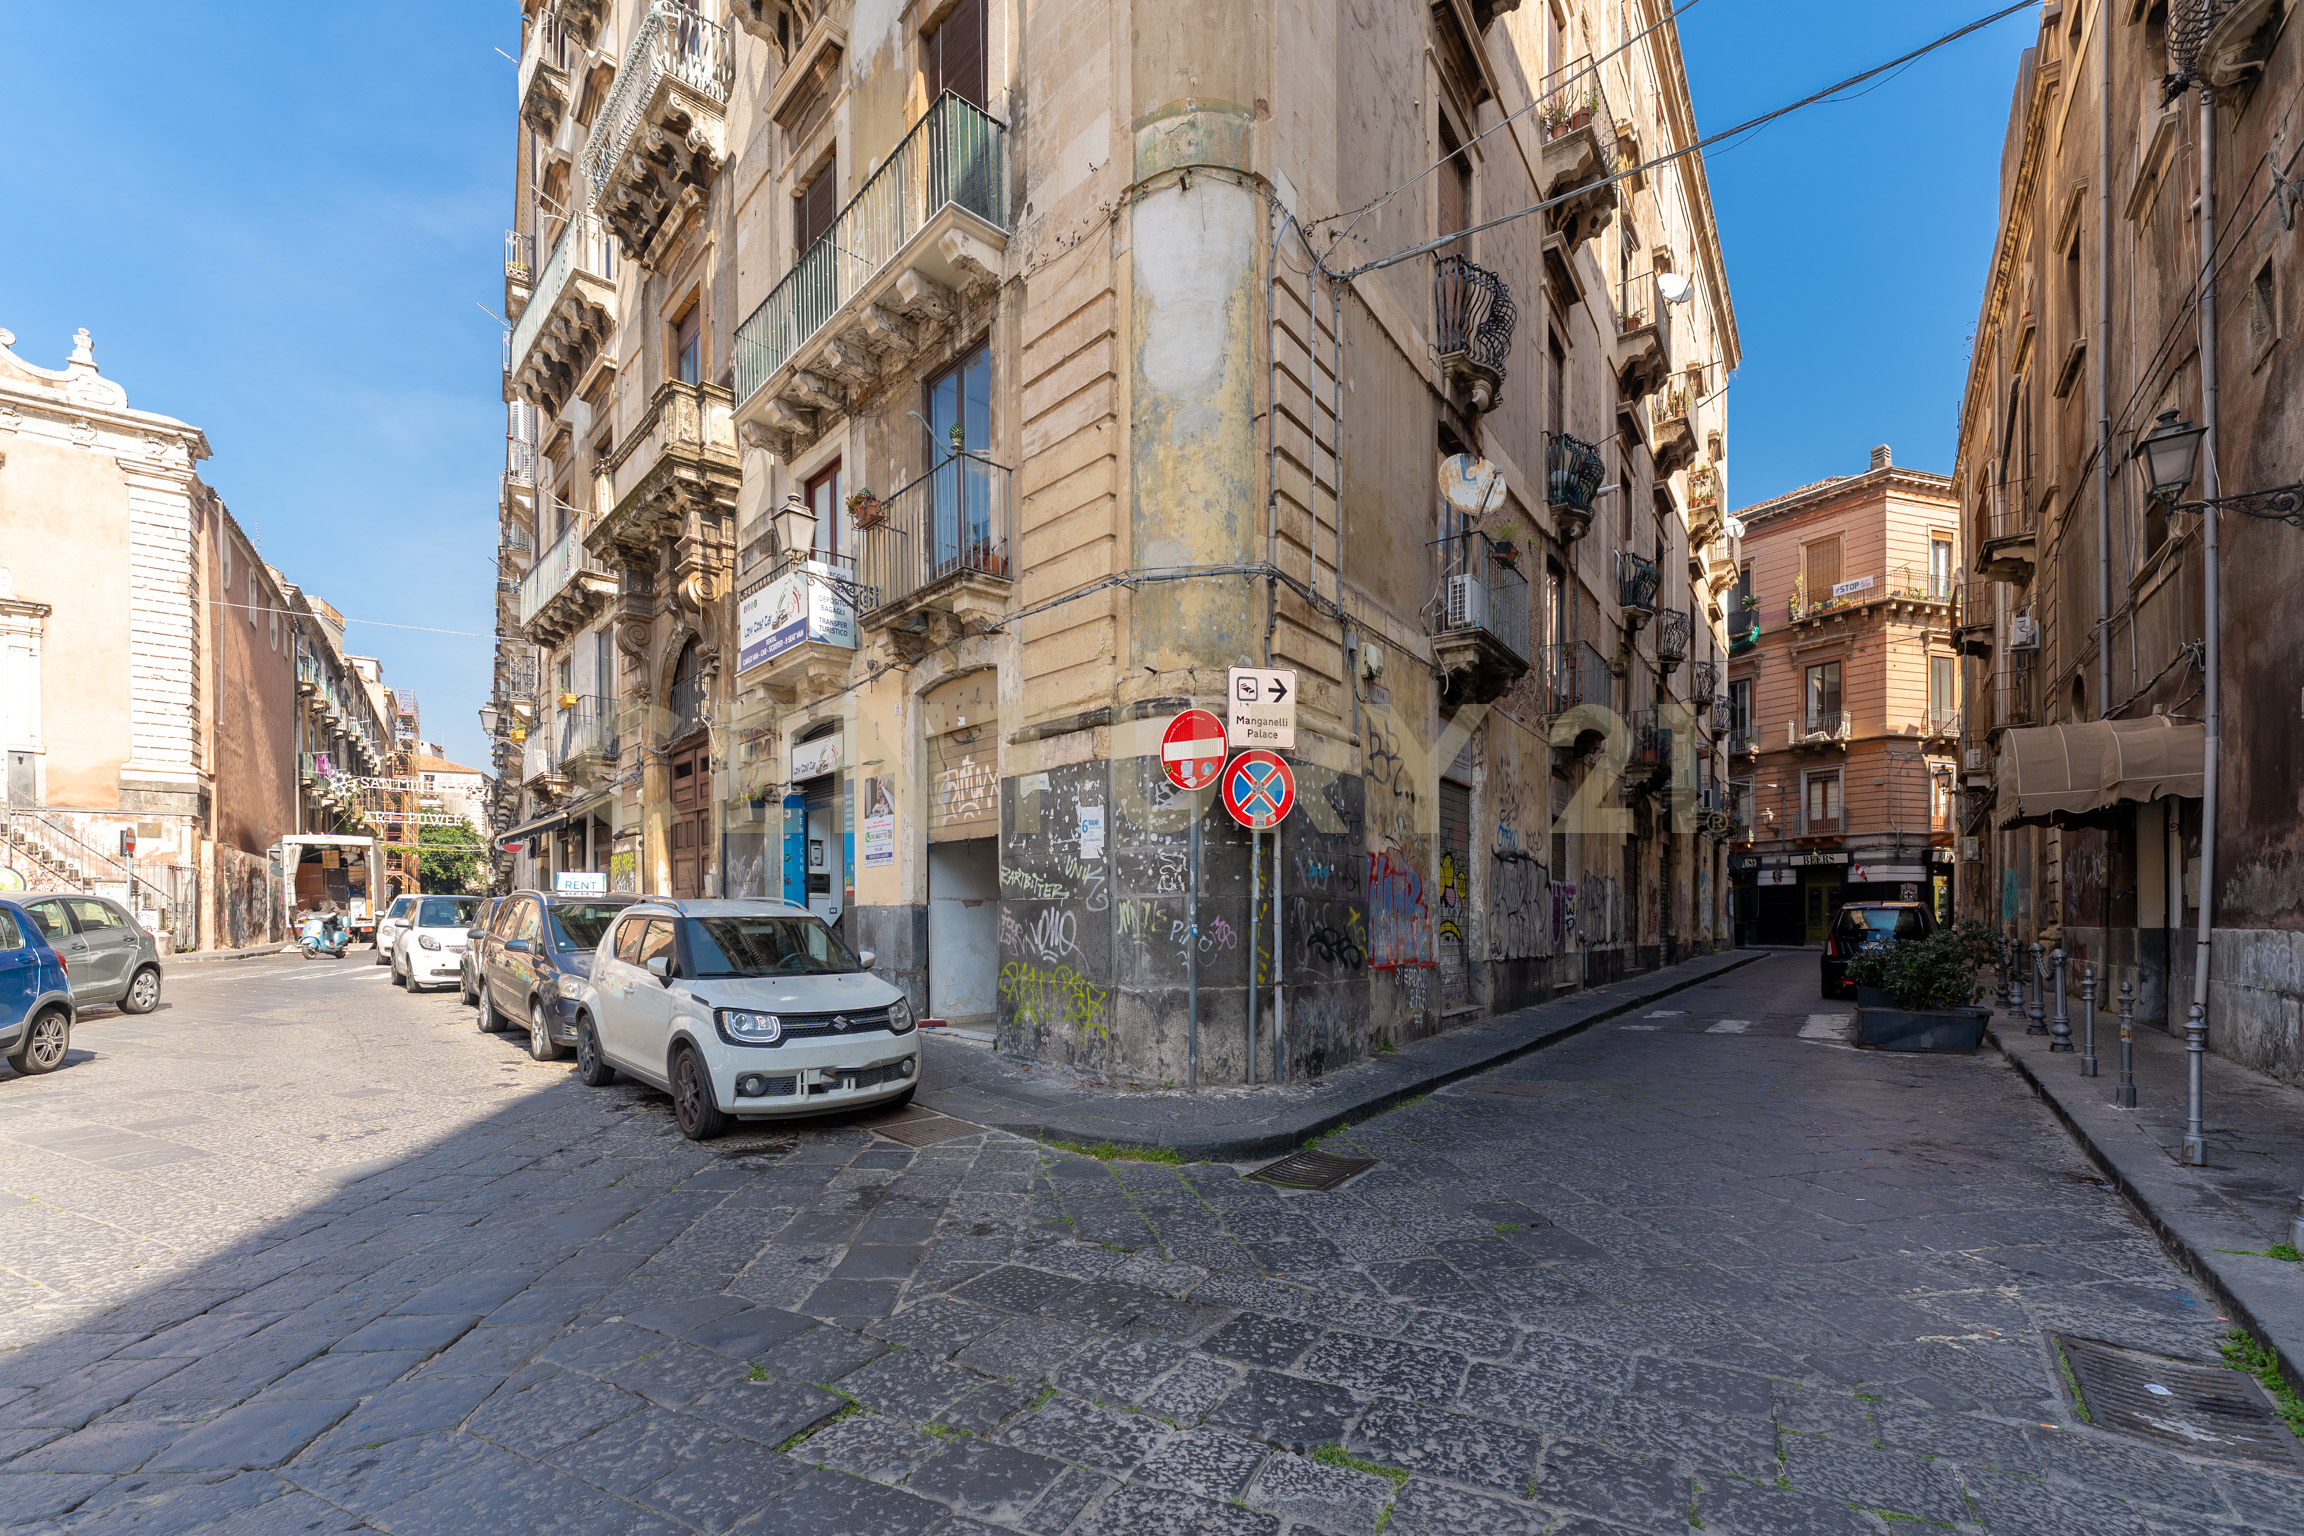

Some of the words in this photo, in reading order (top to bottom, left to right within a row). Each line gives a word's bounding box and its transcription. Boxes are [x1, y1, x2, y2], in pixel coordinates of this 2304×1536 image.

[820, 604, 846, 616] BAGAGLI
[818, 617, 848, 629] TRANSFER
[818, 625, 848, 637] TURISTICO
[768, 640, 783, 652] SCOOTER
[788, 633, 796, 643] SEAT
[1236, 715, 1288, 727] Manganelli
[1247, 728, 1279, 739] Palace
[361, 776, 391, 790] SAN
[363, 811, 394, 824] ART
[409, 812, 463, 827] POWER
[1082, 819, 1089, 833] 6
[1803, 854, 1835, 865] BEERS
[565, 880, 597, 890] RENT
